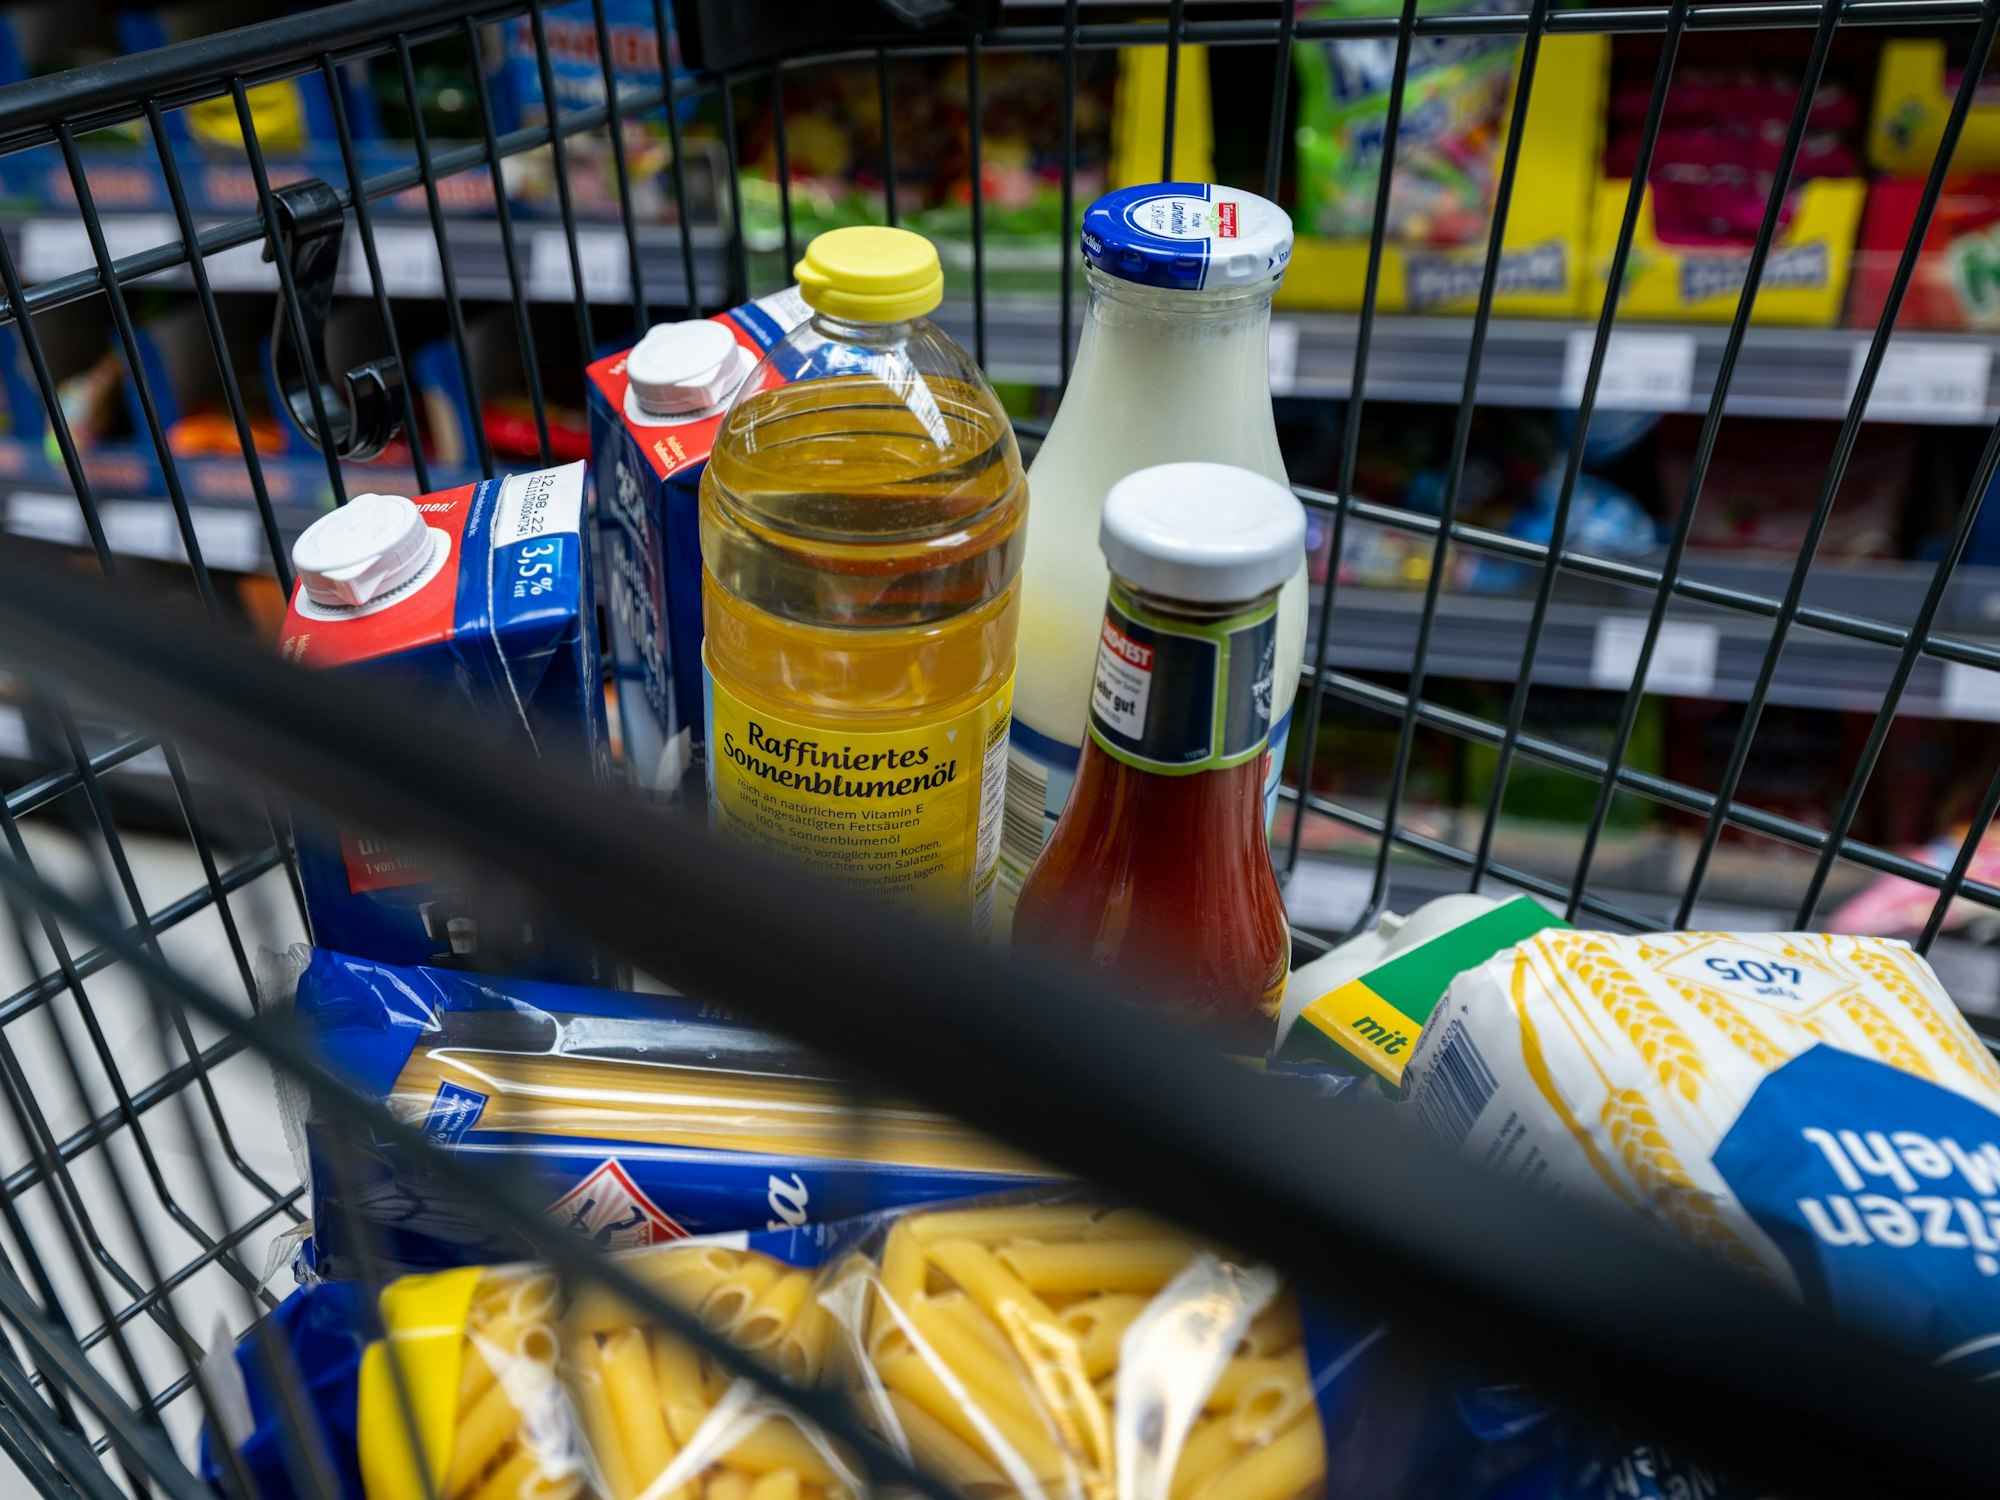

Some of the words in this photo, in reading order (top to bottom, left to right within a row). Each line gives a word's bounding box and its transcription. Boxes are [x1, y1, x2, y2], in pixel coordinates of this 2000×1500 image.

[1171, 202, 1188, 236] Landmilch
[530, 473, 556, 535] 12.08.22
[517, 543, 554, 596] 3,5%
[1114, 692, 1136, 716] gut
[723, 733, 957, 798] Sonnenblumenöl
[748, 721, 929, 771] Raffiniertes
[737, 778, 760, 797] reich
[763, 793, 777, 804] an
[780, 799, 857, 820] natürlichem
[861, 807, 912, 820] Vitamin
[916, 803, 925, 814] E
[740, 792, 758, 807] und
[761, 804, 846, 831] ungesättigten
[850, 818, 920, 832] Fettsäuren
[755, 813, 785, 834] 100%
[789, 826, 901, 847] Sonnenblumenöl
[790, 842, 811, 855] sich
[814, 849, 871, 862] vorzüglich
[874, 851, 898, 860] zum
[803, 856, 864, 872] Anrichten
[868, 862, 891, 871] von
[895, 852, 941, 869] Salaten.
[1705, 957, 1803, 985] 405
[1754, 986, 1804, 1001] Type
[1352, 1016, 1408, 1055] mit
[1801, 1126, 2000, 1197] Mehl
